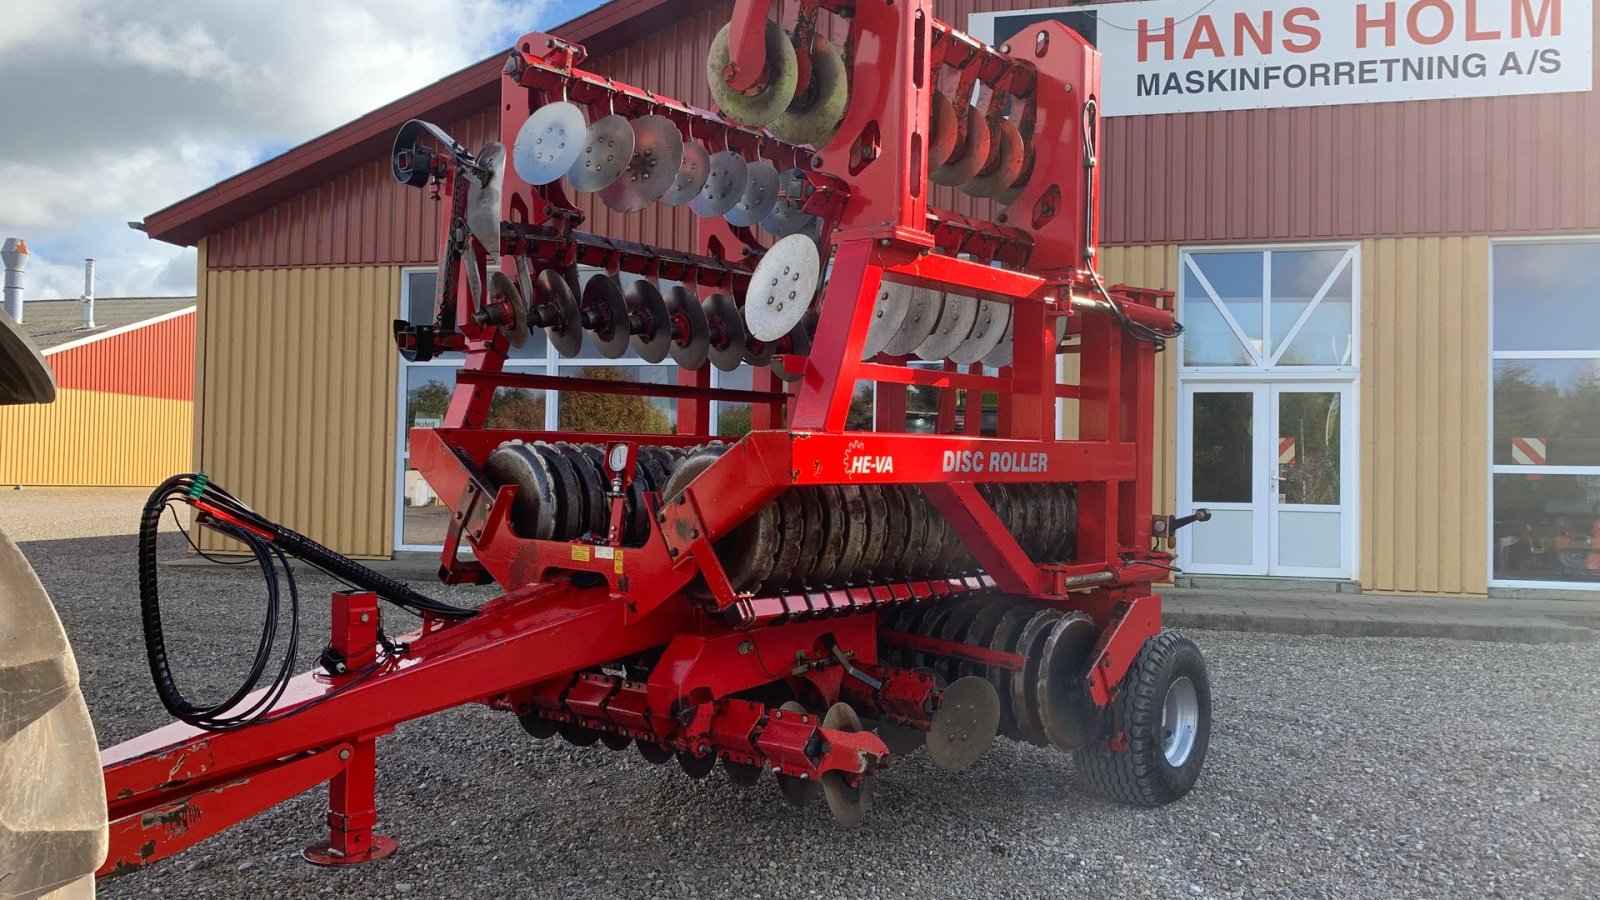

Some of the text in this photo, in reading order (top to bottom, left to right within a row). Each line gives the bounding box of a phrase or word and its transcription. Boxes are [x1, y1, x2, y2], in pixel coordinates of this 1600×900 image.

[1137, 0, 1561, 62] HANS HOLM
[1137, 48, 1562, 97] MASKINFORRETNING A/S
[851, 455, 894, 474] HE-VA
[943, 451, 1047, 473] DISC ROLLER
